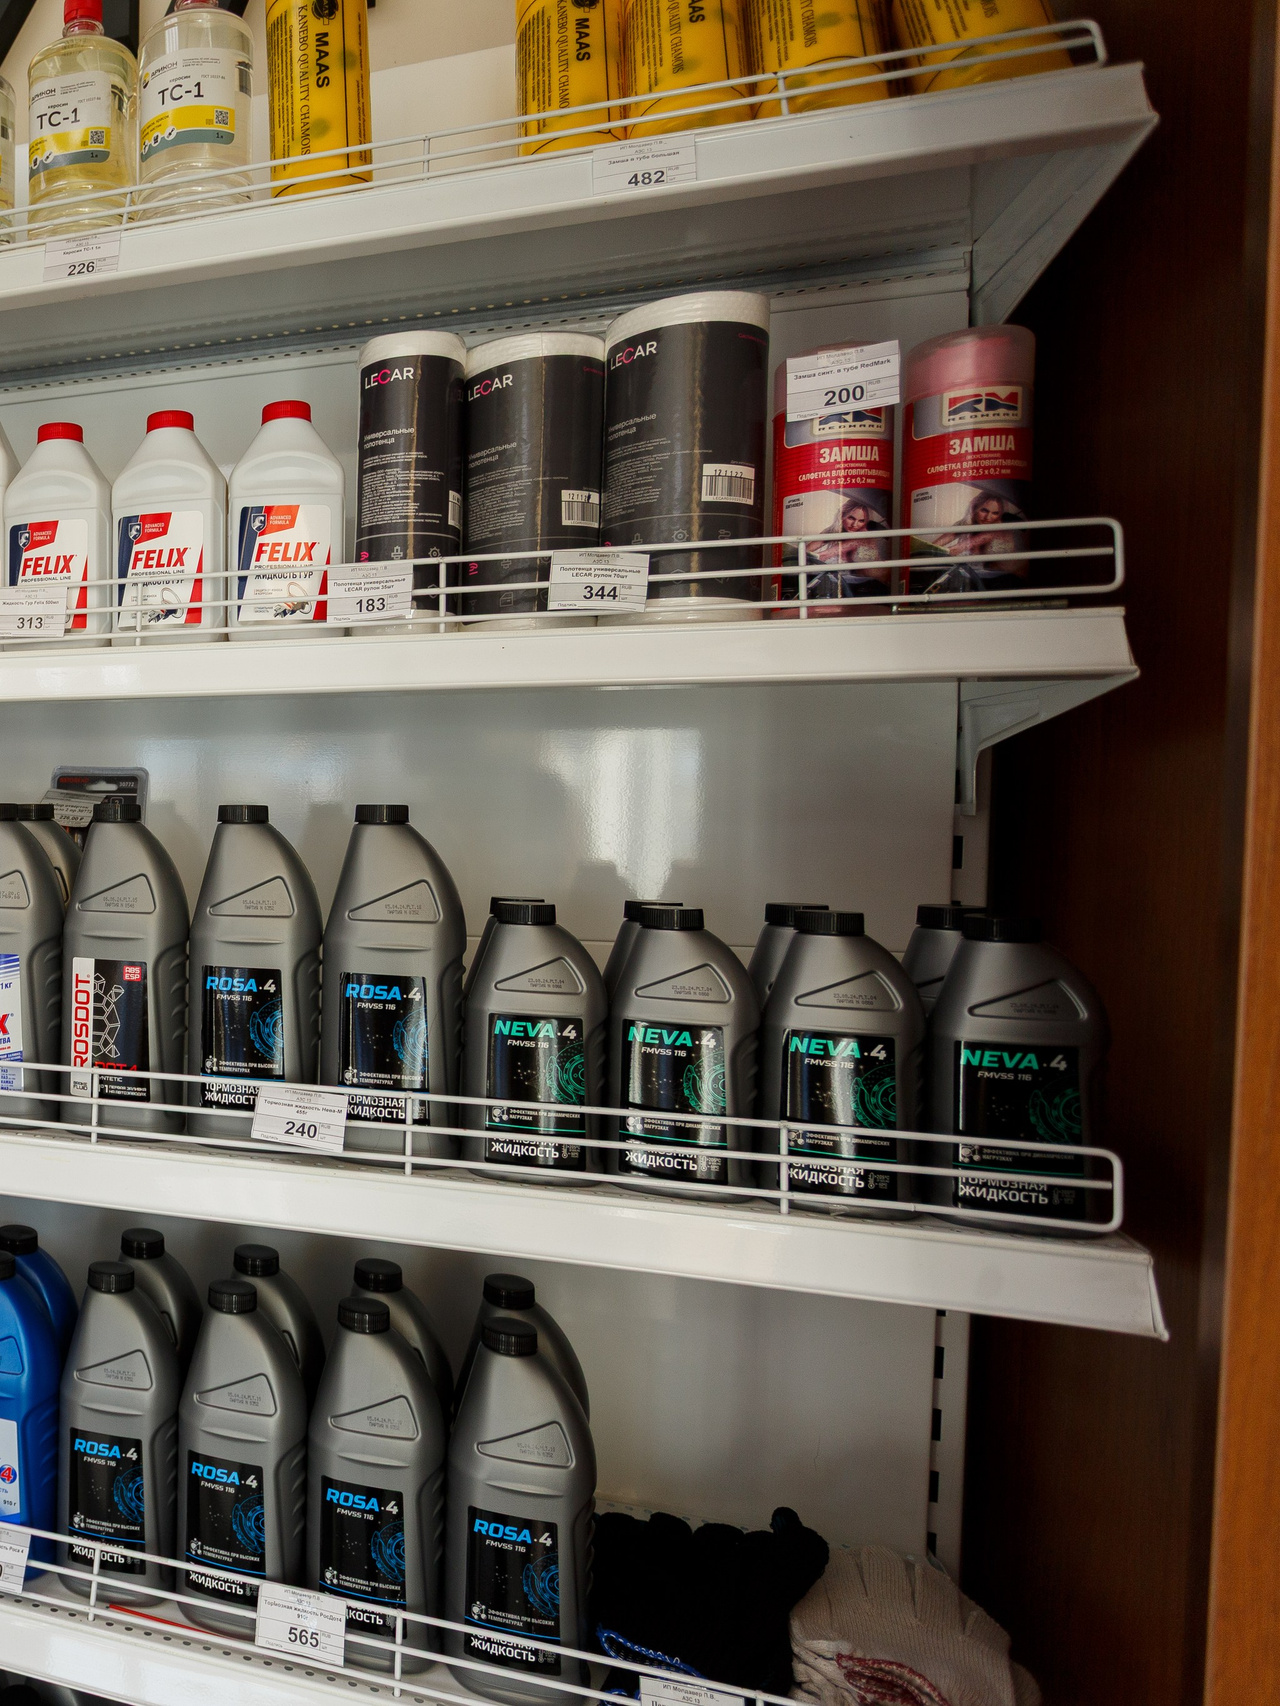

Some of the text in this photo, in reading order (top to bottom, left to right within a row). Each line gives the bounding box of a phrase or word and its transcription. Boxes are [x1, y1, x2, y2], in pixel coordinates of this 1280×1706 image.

[575, 17, 591, 62] MAAS
[315, 32, 330, 89] MAAS
[297, 53, 310, 103] QUALITY
[627, 170, 665, 186] 482
[67, 261, 95, 276] 226
[610, 341, 658, 371] LECAR
[860, 359, 891, 369] RedMark
[364, 367, 414, 390] LECAR
[468, 374, 514, 402] LECAR
[824, 385, 865, 406] 200
[947, 411, 1019, 423] REDMARK
[818, 423, 883, 432] REDMARK
[949, 434, 1016, 455] ЗАМША
[820, 445, 880, 464] ЗАМША
[131, 547, 189, 570] FELIX
[255, 541, 318, 562] FELIX
[21, 554, 74, 577] FELIX
[363, 577, 406, 586] универсальные
[583, 585, 618, 600] 344
[356, 597, 386, 613] 183
[17, 616, 43, 630] 313
[124, 966, 141, 974] ABS
[124, 973, 141, 981] ESP
[357, 1002, 396, 1011] FMVSS 116
[73, 973, 90, 1067] ROSDOT
[507, 1040, 536, 1048] FMVSS
[641, 1047, 687, 1057] FMVSS 116
[804, 1058, 854, 1069] FMVSS 116
[977, 1070, 1032, 1082] FMVSS 116
[264, 1099, 294, 1108] Тормозная
[294, 1104, 321, 1112] жидкость
[284, 1121, 317, 1138] 240
[491, 1142, 560, 1159] ЖИДКОСТЬ
[625, 1151, 698, 1171] ЖИДКОСТЬ
[789, 1168, 865, 1189] ЖИДКОСТЬ
[960, 1185, 1049, 1206] ЖИДКОСТЬ
[83, 1456, 105, 1466] FMVSS
[0, 1466, 14, 1483] 4
[200, 1480, 236, 1494] FMVSS 116
[336, 1507, 374, 1521] FMVSS 116
[485, 1539, 527, 1553] FMVSS 116
[189, 1571, 244, 1595] ЖИДКОСТЬ
[487, 1614, 524, 1628] ТЕМПЕРАТУРАХ
[288, 1626, 320, 1648] 565
[470, 1637, 536, 1663] ЖИДКОСТЬ
[672, 1686, 703, 1698] Молдавер
